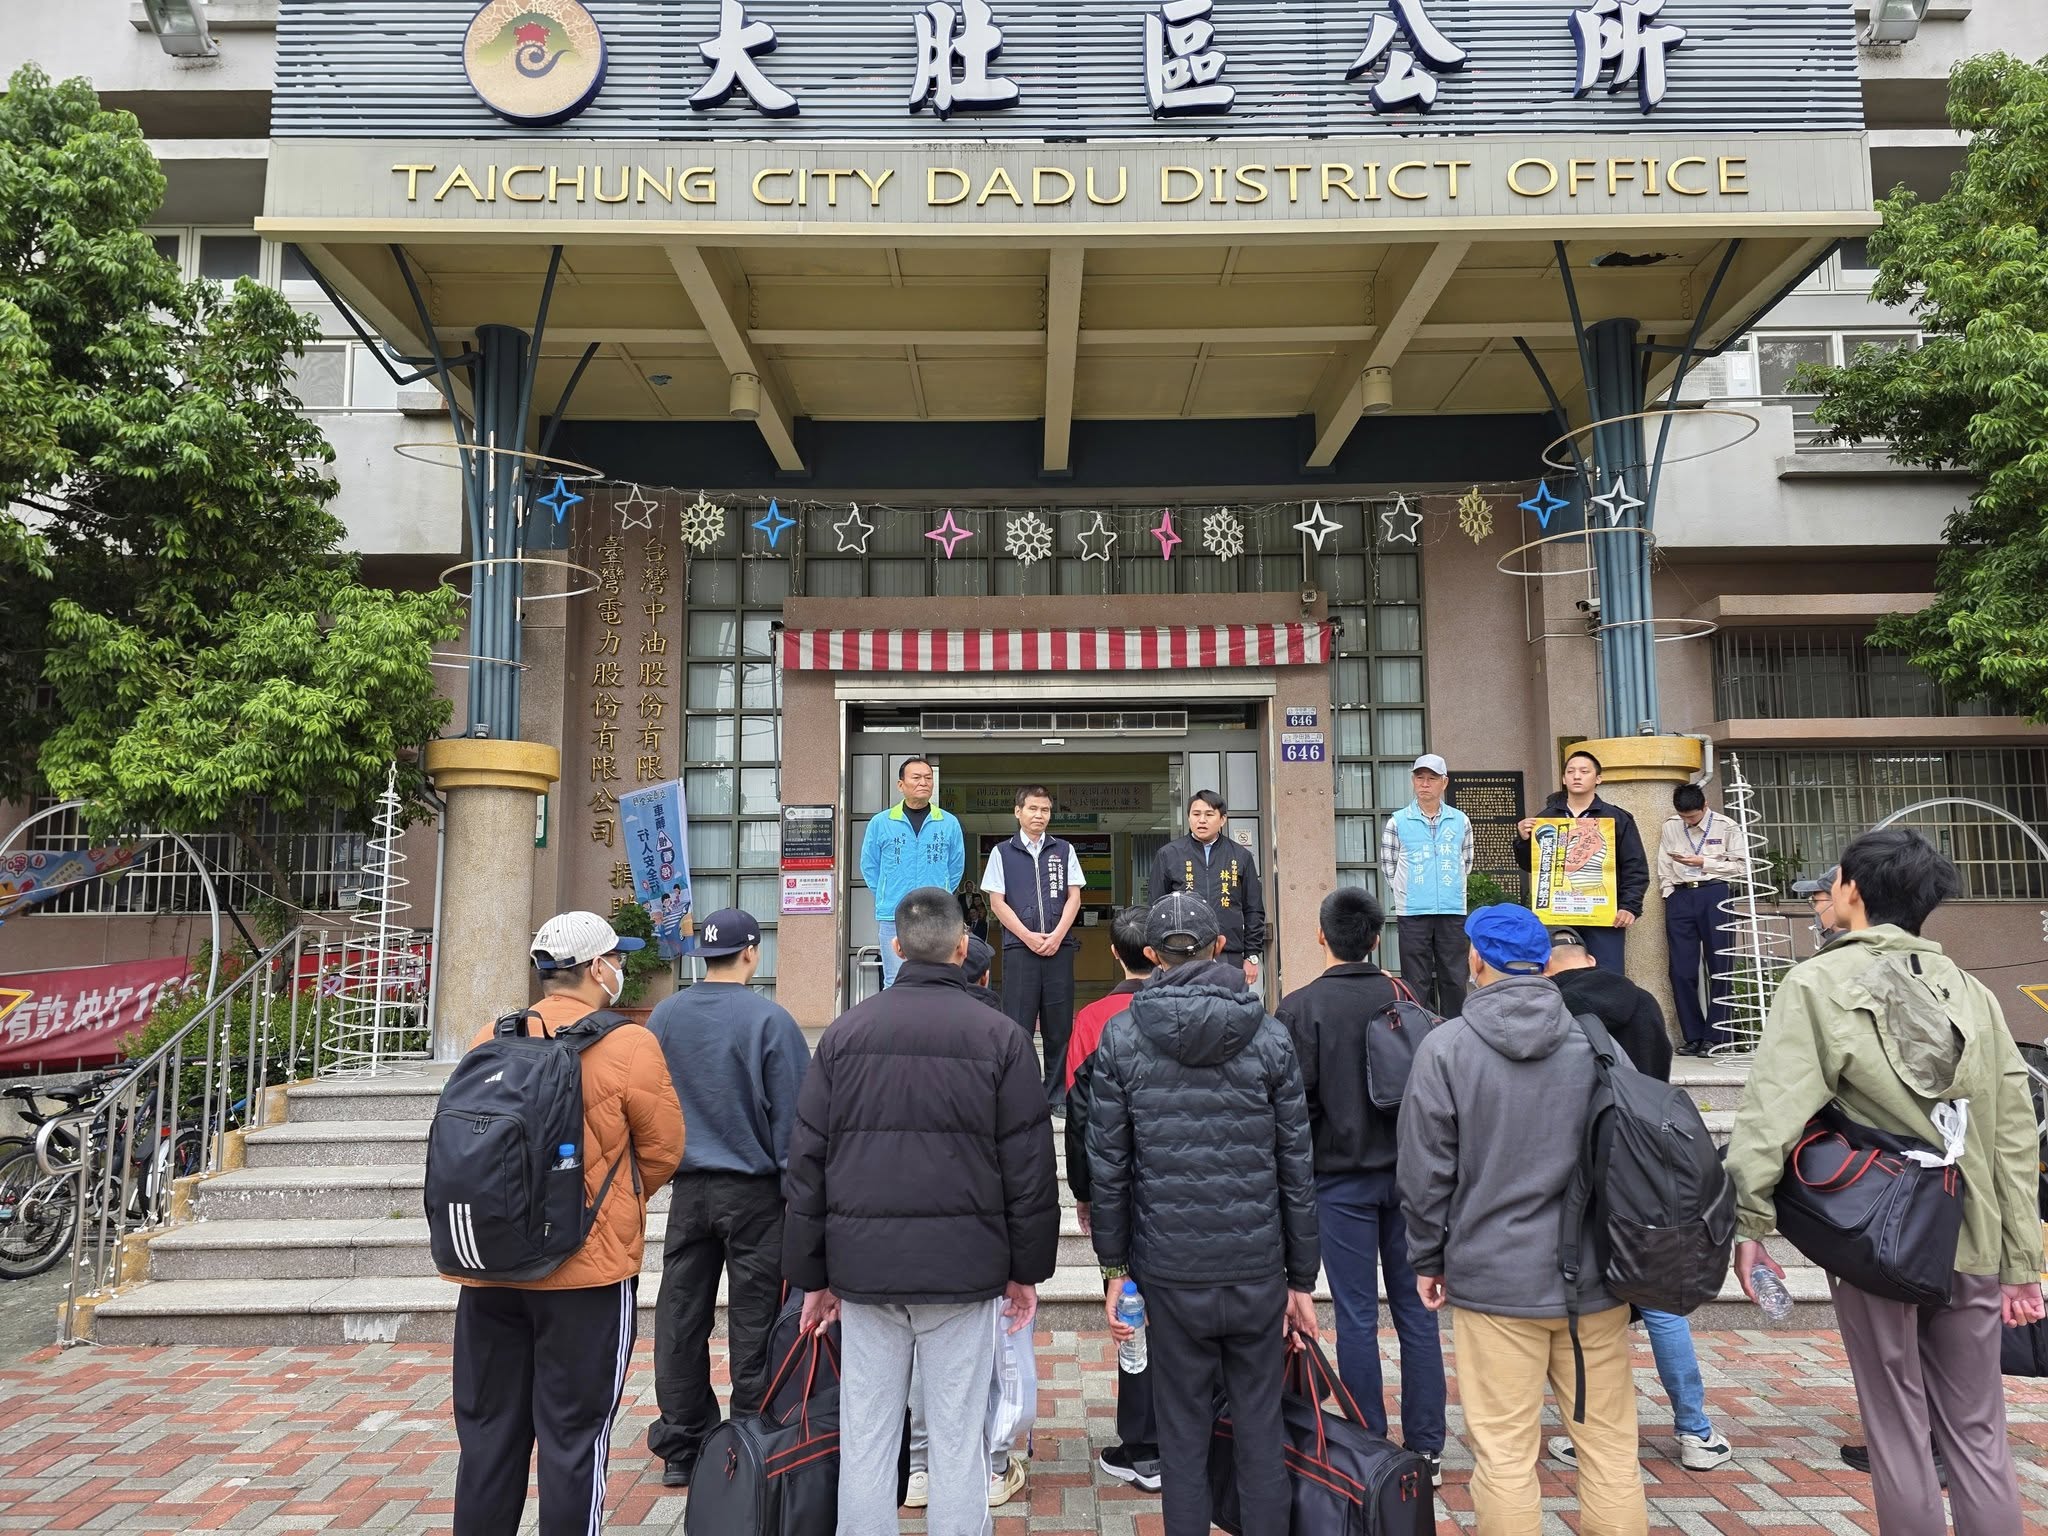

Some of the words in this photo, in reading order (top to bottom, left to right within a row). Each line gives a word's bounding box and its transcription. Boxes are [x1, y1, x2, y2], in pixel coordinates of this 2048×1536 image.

[689, 0, 1688, 119] 大肚區公所
[391, 163, 717, 205] TAICHUNG
[752, 166, 895, 206] CITY
[926, 165, 1129, 206] DADU
[1161, 159, 1473, 205] DISTRICT
[1507, 156, 1750, 197] OFFICE
[636, 537, 670, 782] 台灣中油股份有限
[588, 535, 626, 848] 臺灣電力股份有限公司
[1291, 715, 1313, 726] 646
[1287, 745, 1320, 761] 646
[704, 924, 719, 942] NY
